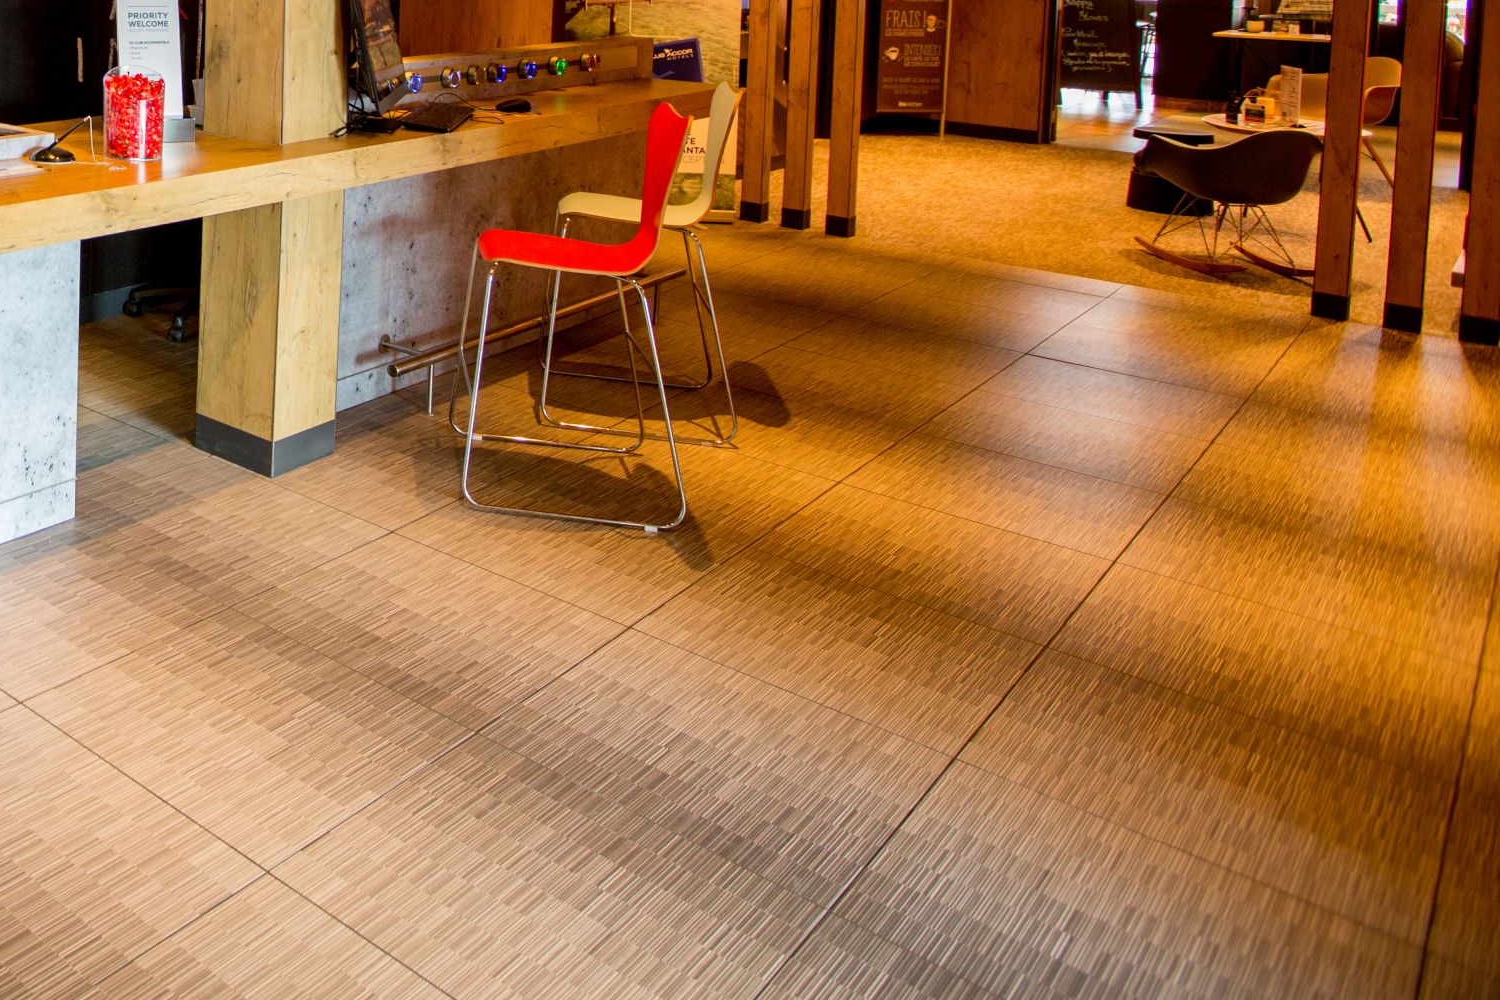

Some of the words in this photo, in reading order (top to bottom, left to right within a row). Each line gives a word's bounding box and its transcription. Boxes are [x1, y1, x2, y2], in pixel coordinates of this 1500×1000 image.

[129, 20, 169, 28] WELCOME
[886, 10, 921, 28] FRAIS
[653, 51, 665, 59] LUB
[667, 48, 693, 57] ACCOR
